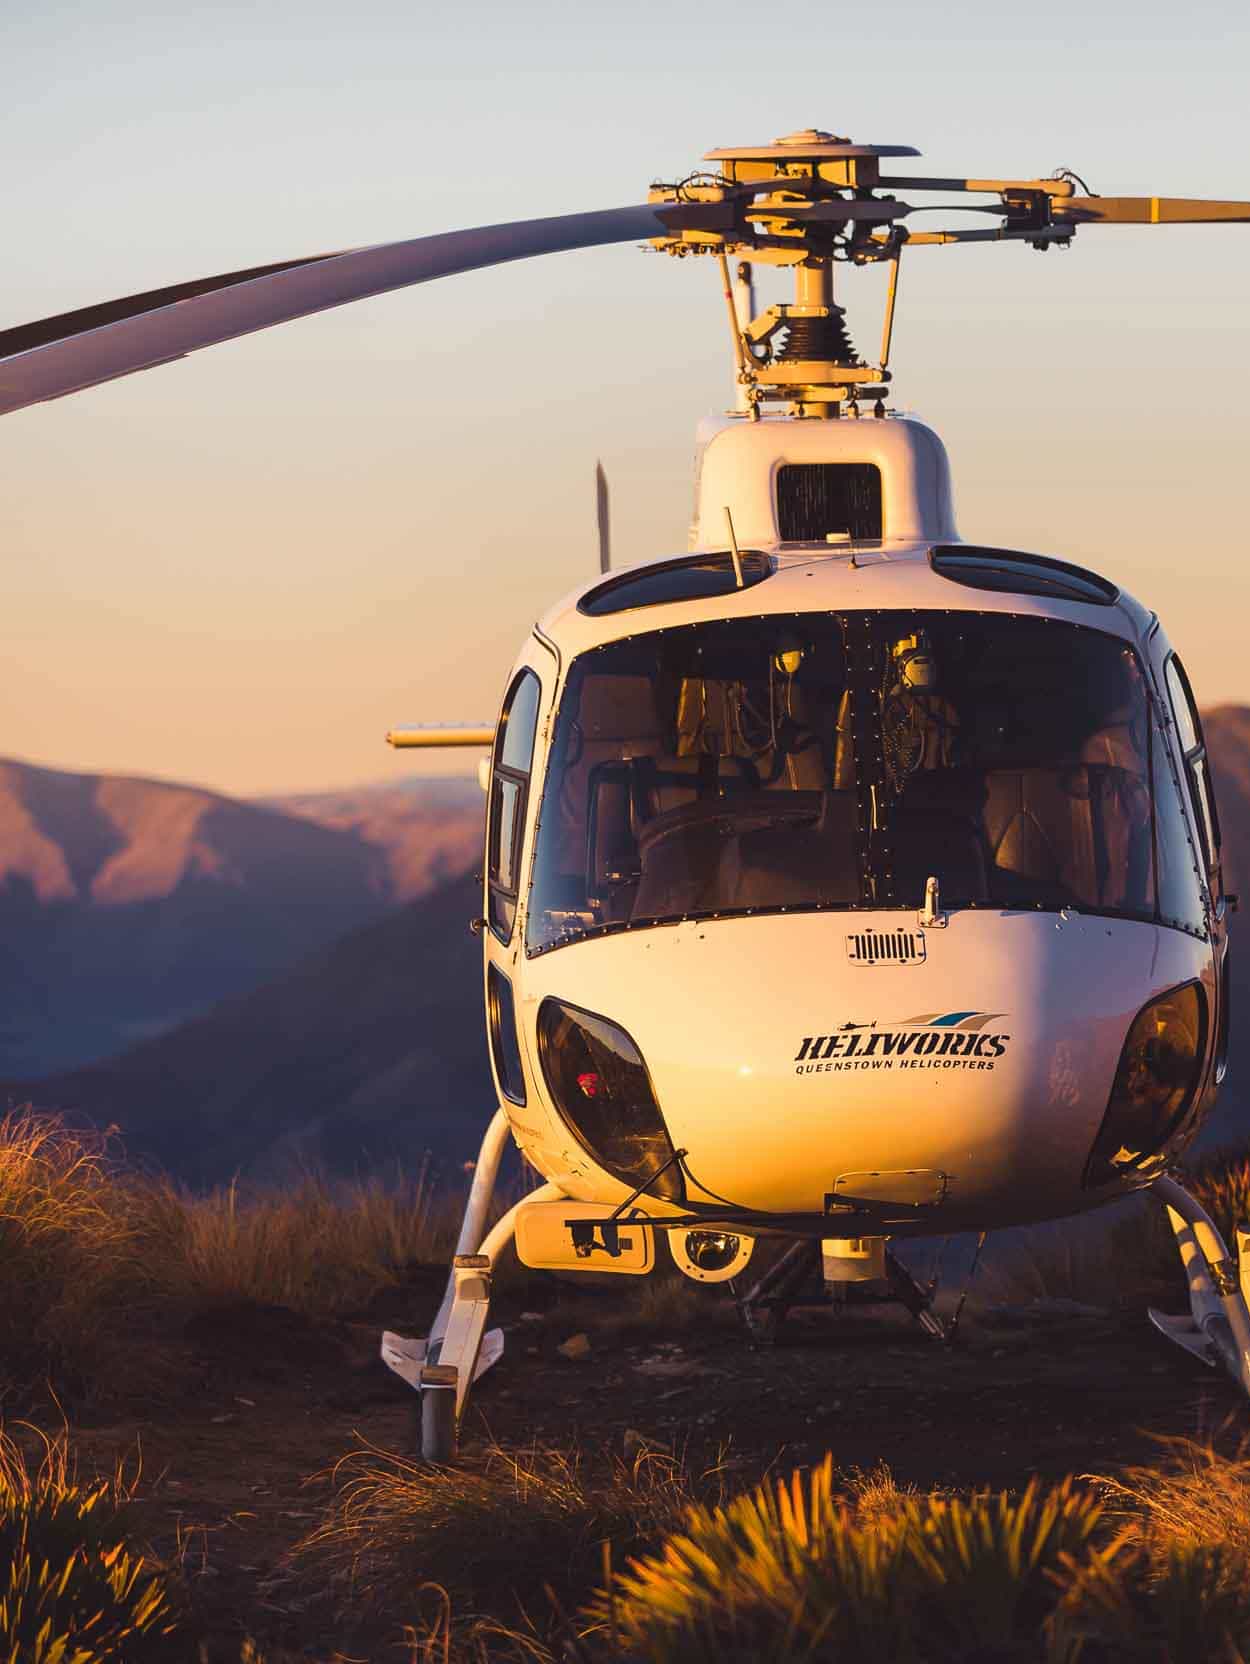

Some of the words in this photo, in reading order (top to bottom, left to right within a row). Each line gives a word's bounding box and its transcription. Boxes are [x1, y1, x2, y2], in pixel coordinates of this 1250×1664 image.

[794, 1032, 1010, 1061] HELIWORKS
[795, 1060, 893, 1075] QUEENSTOWN
[899, 1059, 995, 1071] HELICOPTERS
